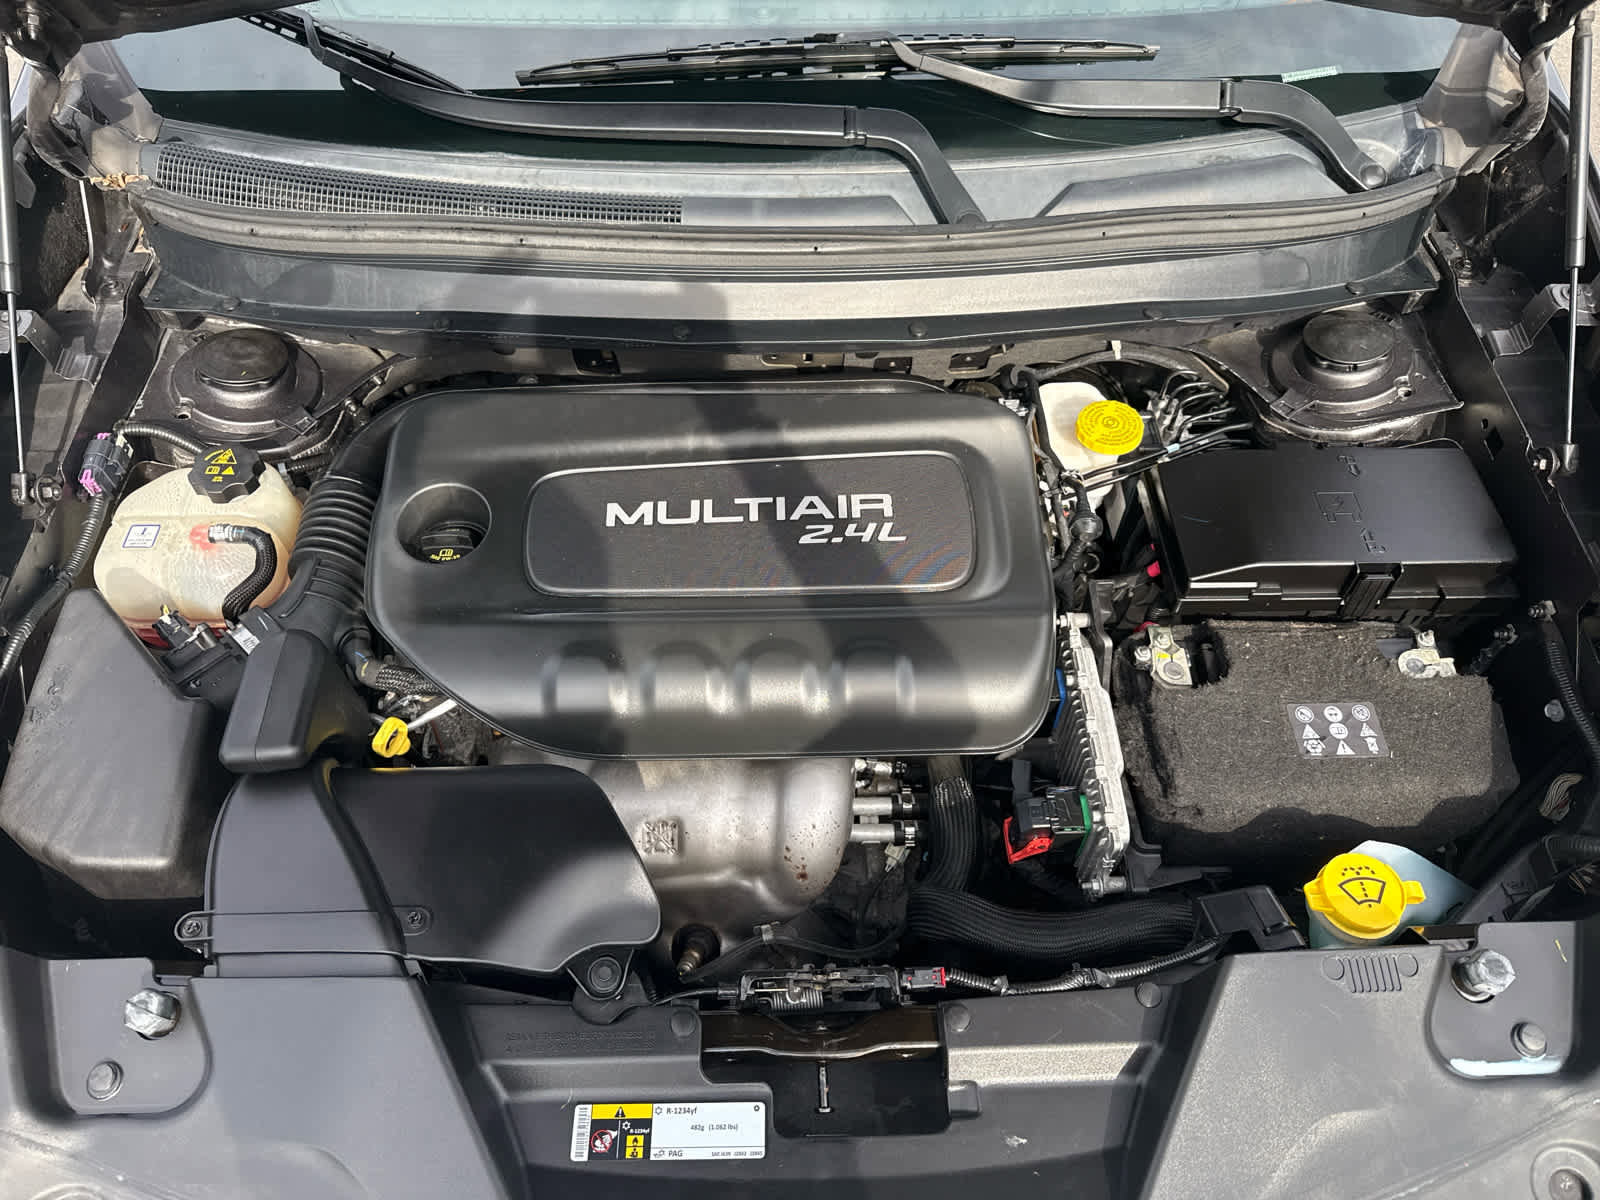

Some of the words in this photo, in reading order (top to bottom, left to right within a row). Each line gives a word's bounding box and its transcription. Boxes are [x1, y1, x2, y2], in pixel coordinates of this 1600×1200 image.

[605, 493, 894, 528] MULTIAIR
[798, 521, 908, 544] 2.4L
[666, 1105, 698, 1116] R-1234yf
[668, 1149, 683, 1157] PAG
